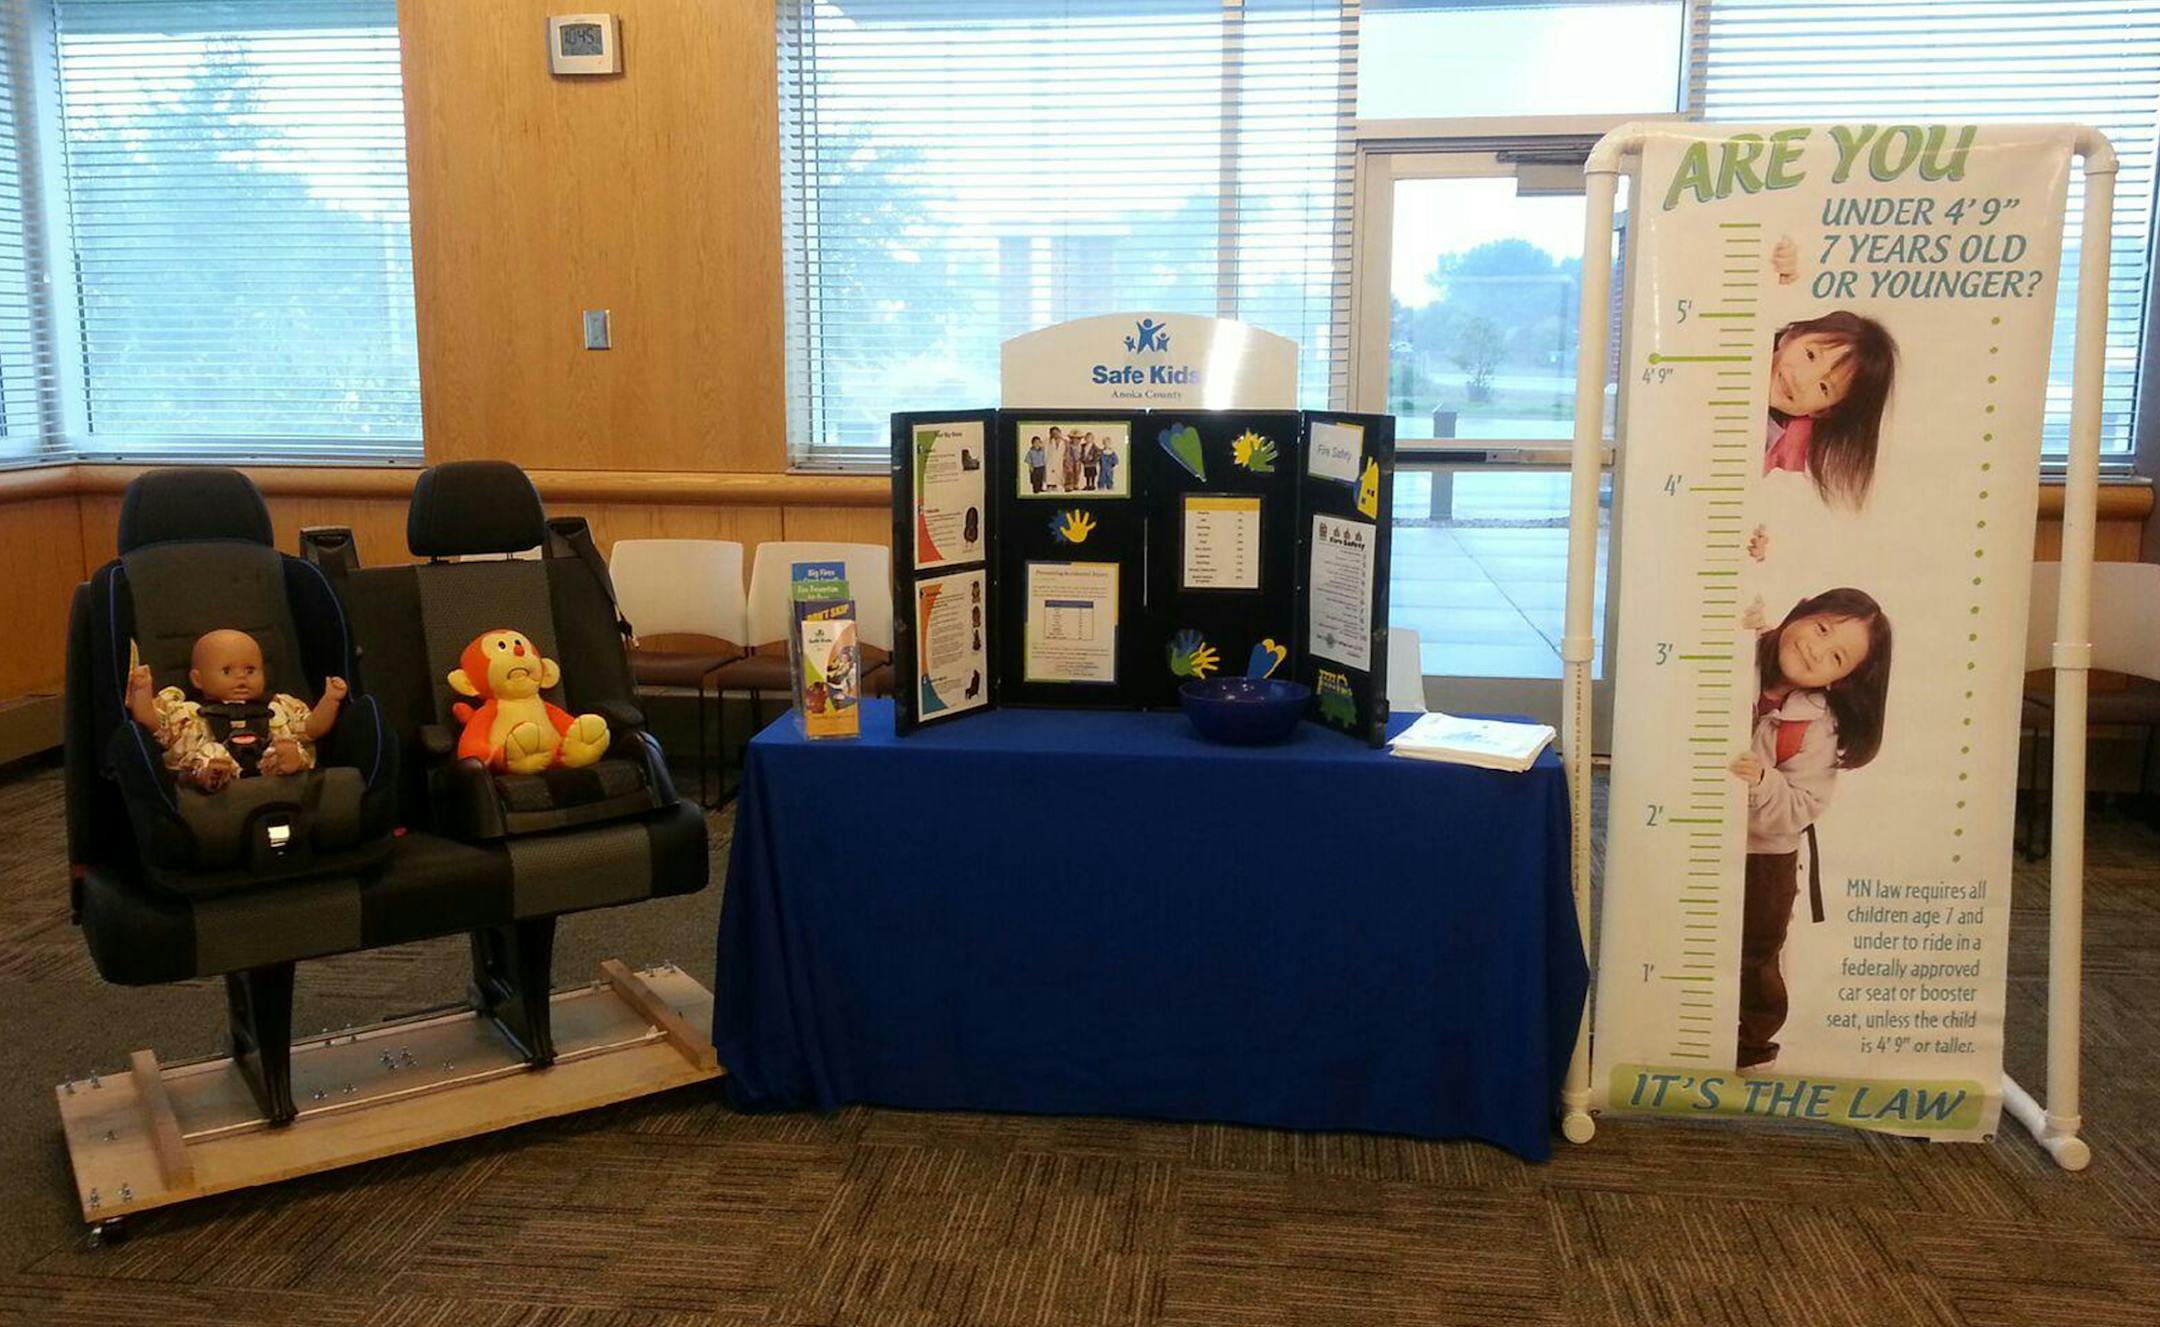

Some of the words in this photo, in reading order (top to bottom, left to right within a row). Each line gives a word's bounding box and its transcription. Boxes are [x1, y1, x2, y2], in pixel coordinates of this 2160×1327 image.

[1663, 128, 1812, 211] ARE
[1829, 125, 1978, 183] YOU
[1822, 198, 1935, 226] UNDER
[1820, 235, 1841, 264] 7
[1849, 234, 1952, 264] YEARS
[1959, 234, 2027, 263] OLD
[1812, 271, 1858, 299] OR
[1870, 270, 2043, 298] YOUNGER?
[1677, 299, 1692, 324] 5'
[1092, 365, 1144, 384] Safe
[1150, 365, 1200, 384] Kids
[1111, 389, 1142, 399] Anoka
[1145, 389, 1182, 400] County
[1664, 474, 1682, 496] 4'
[1656, 642, 1673, 665] 3'
[1647, 804, 1663, 827] 2'
[1847, 879, 1871, 897] MN
[1876, 880, 1900, 898] law
[1905, 882, 1966, 902] requires
[1969, 880, 1987, 899] all
[1847, 906, 1908, 924] children
[1912, 911, 1940, 928] age
[1945, 907, 1954, 924] 7
[1957, 907, 1984, 924] and
[1853, 932, 1901, 950] under
[1902, 934, 1918, 950] to
[1923, 933, 1953, 951] ride
[1956, 934, 1970, 950] in
[1972, 938, 1982, 950] a
[1643, 963, 1655, 982] 1'
[1842, 957, 1906, 979] federally
[1910, 959, 1980, 979] approved
[1838, 987, 1862, 1001] car
[1866, 985, 1896, 1001] seat
[1900, 987, 1915, 1001] or
[1920, 984, 1977, 1001] booster
[1827, 1013, 1862, 1030] seat,
[1866, 1010, 1910, 1028] unless
[1914, 1010, 1938, 1028] the
[1942, 1010, 1977, 1028] child
[1861, 1036, 1872, 1053] is
[1914, 1041, 1929, 1054] or
[1935, 1038, 1976, 1054] taller.
[1629, 1073, 1725, 1111] IT'S
[1743, 1080, 1838, 1118] THE
[1846, 1085, 1966, 1121] LAW
